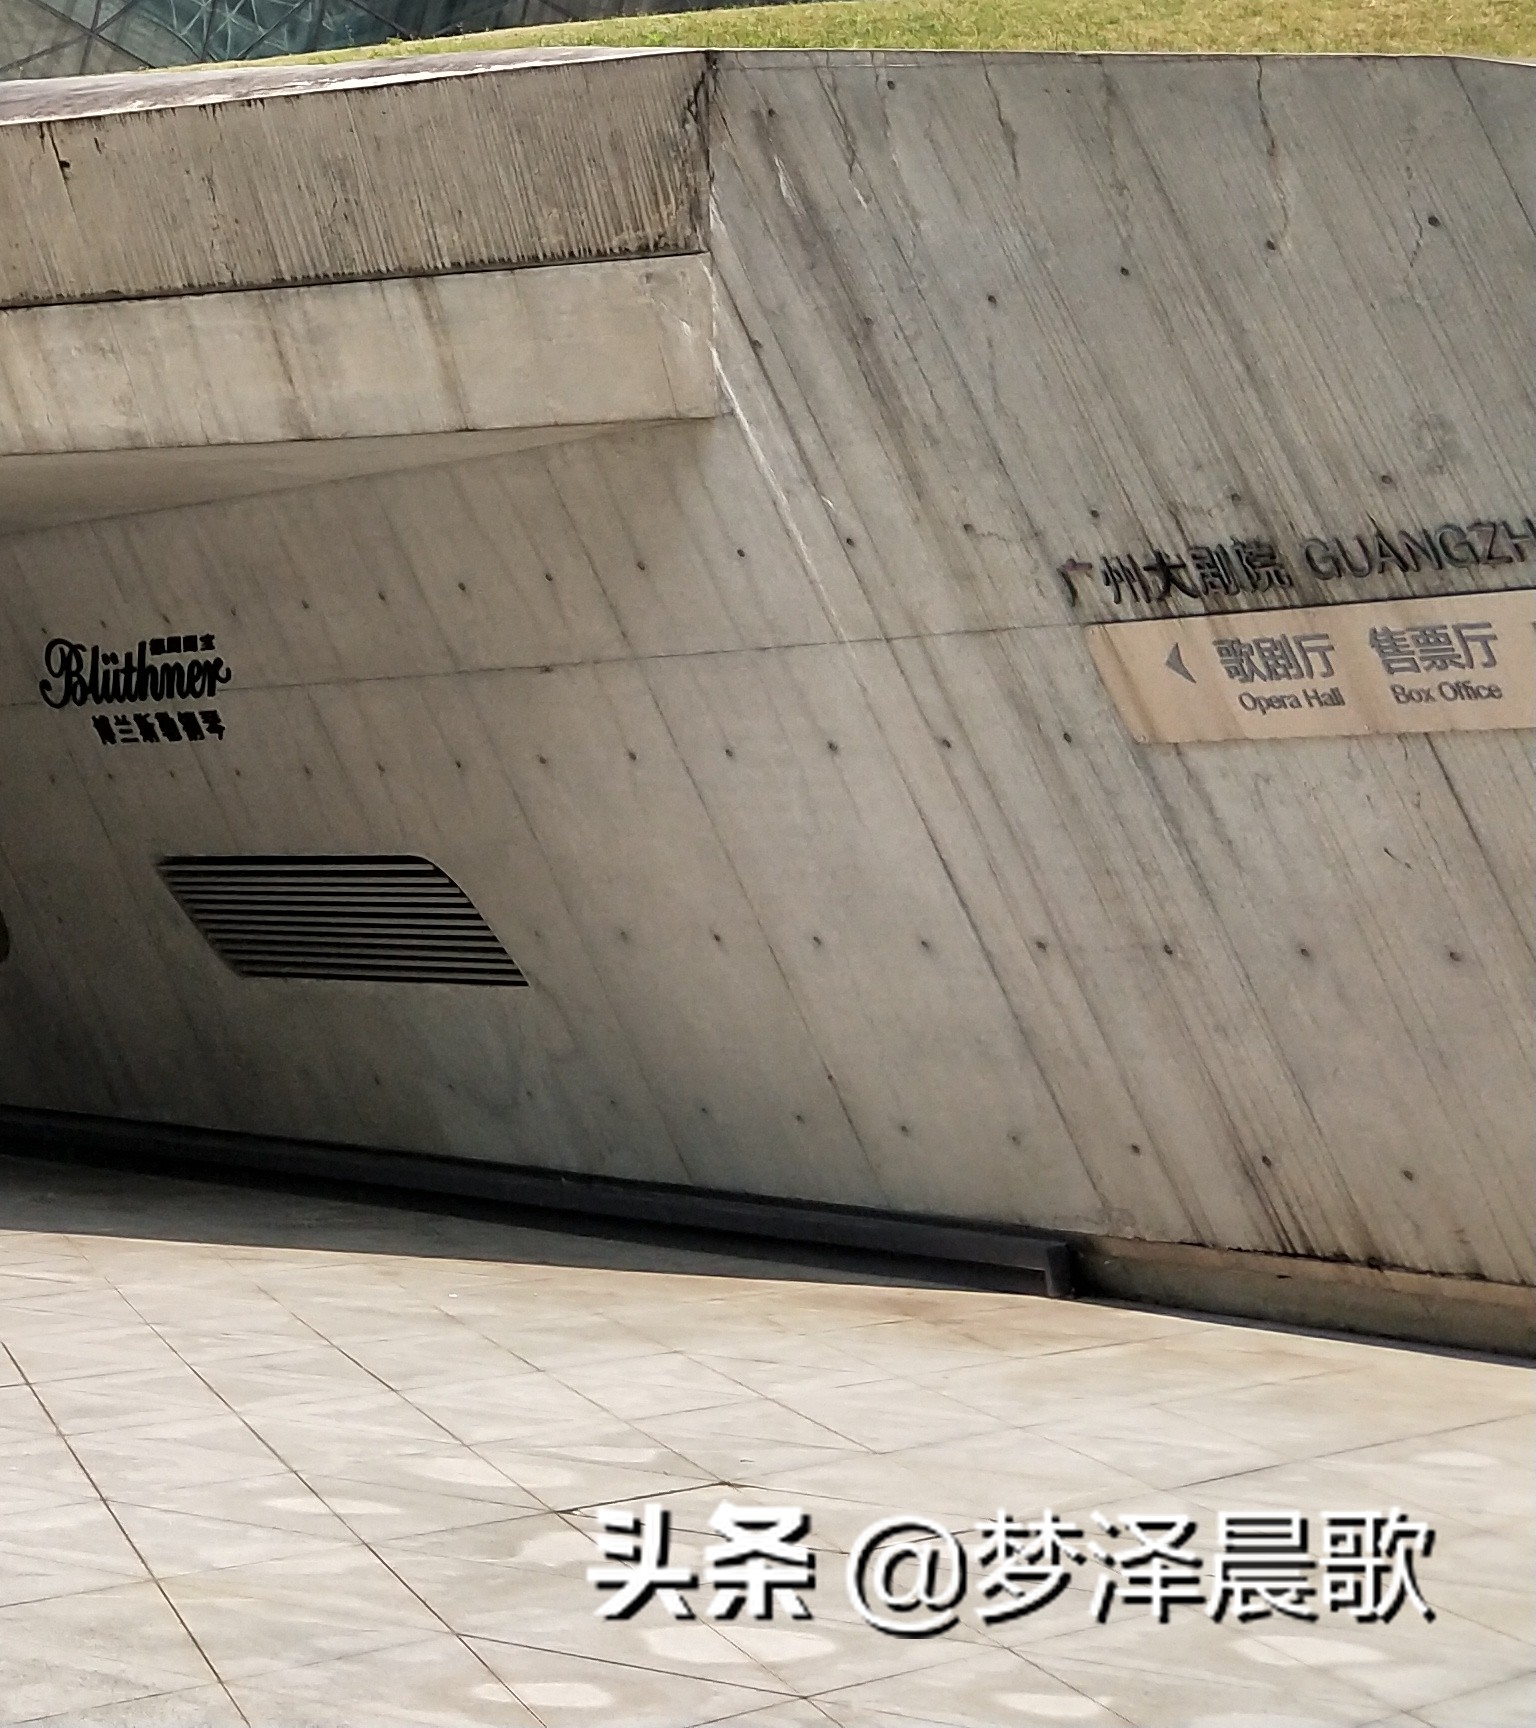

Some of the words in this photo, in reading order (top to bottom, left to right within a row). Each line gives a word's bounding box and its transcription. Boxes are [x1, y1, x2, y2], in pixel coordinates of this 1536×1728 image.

[1057, 537, 1294, 607] 广州大剧院
[39, 638, 232, 709] Blüthner
[1212, 633, 1335, 683] 歌剧厅
[1369, 622, 1498, 674] 售票厅
[1238, 692, 1302, 715] Opera
[1301, 687, 1346, 708] Hall
[1390, 683, 1436, 704] Box
[1438, 680, 1503, 701] Office
